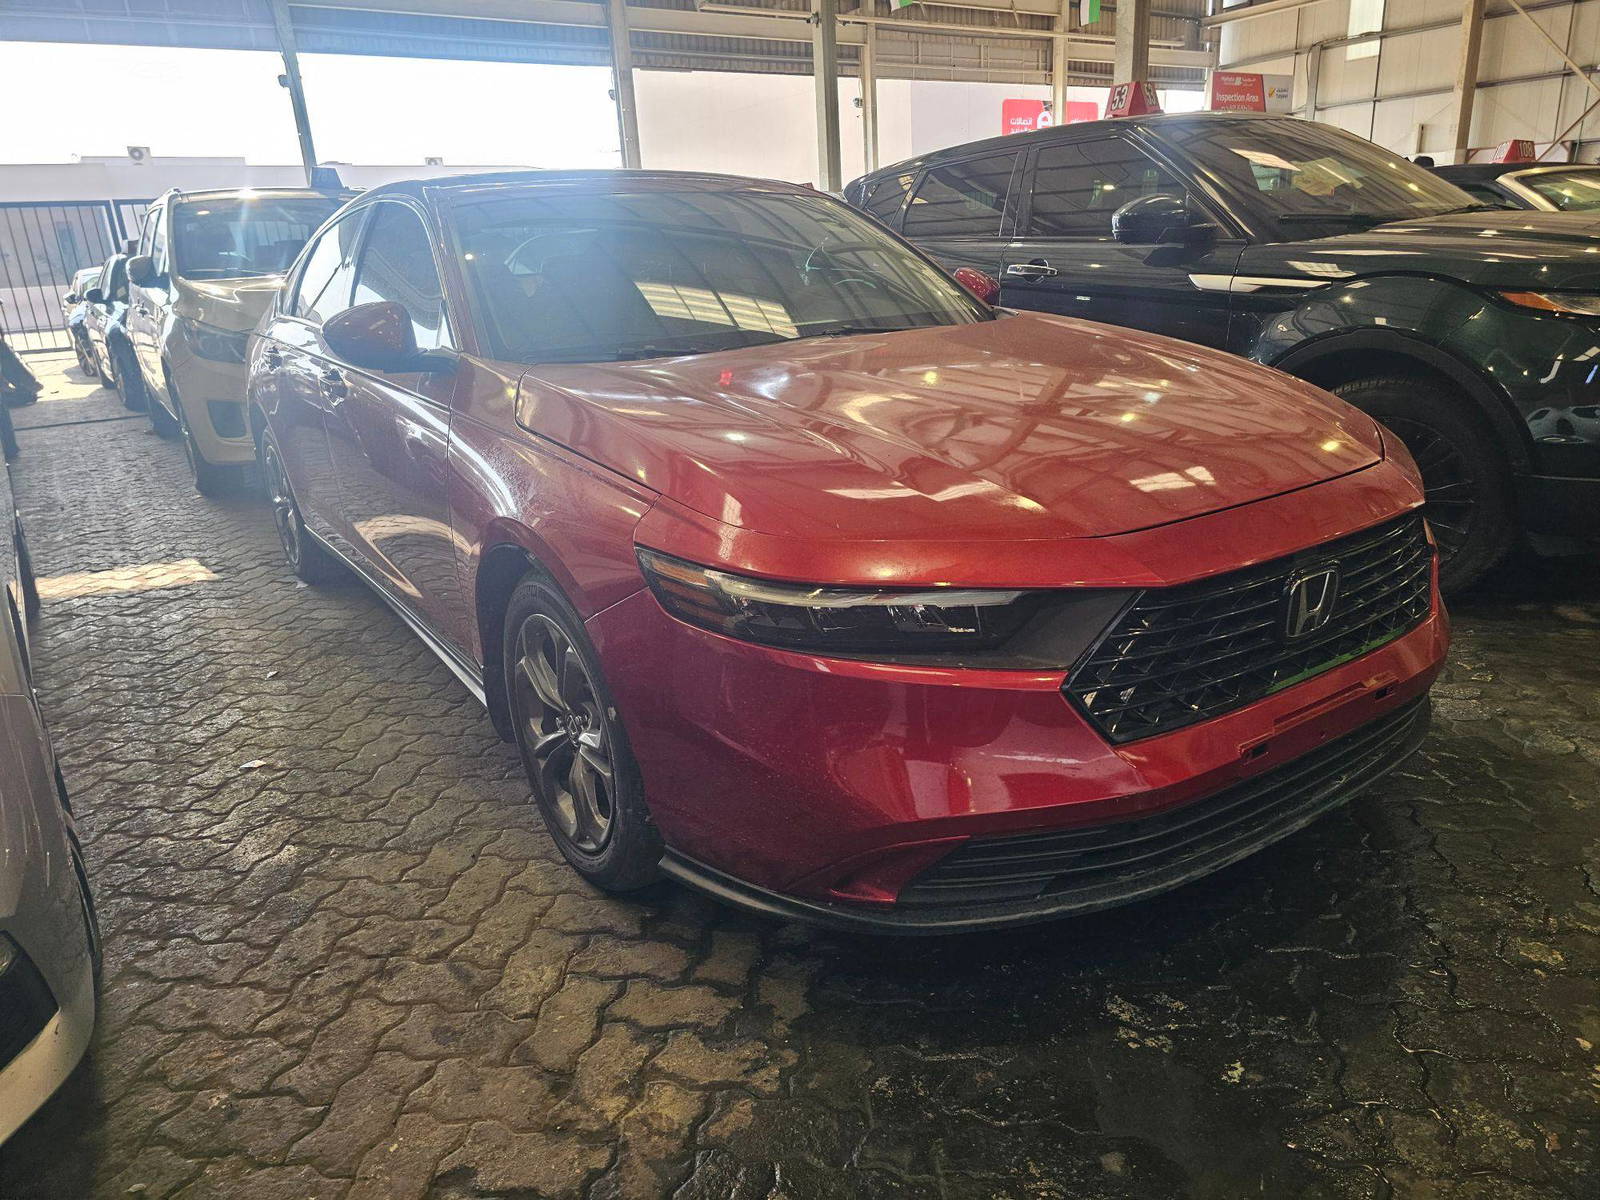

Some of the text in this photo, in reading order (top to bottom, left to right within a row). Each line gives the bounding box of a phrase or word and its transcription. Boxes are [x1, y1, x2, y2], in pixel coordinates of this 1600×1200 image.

[1111, 85, 1129, 110] 53
[1216, 92, 1259, 103] Inspection Area
[1519, 141, 1534, 158] 108
